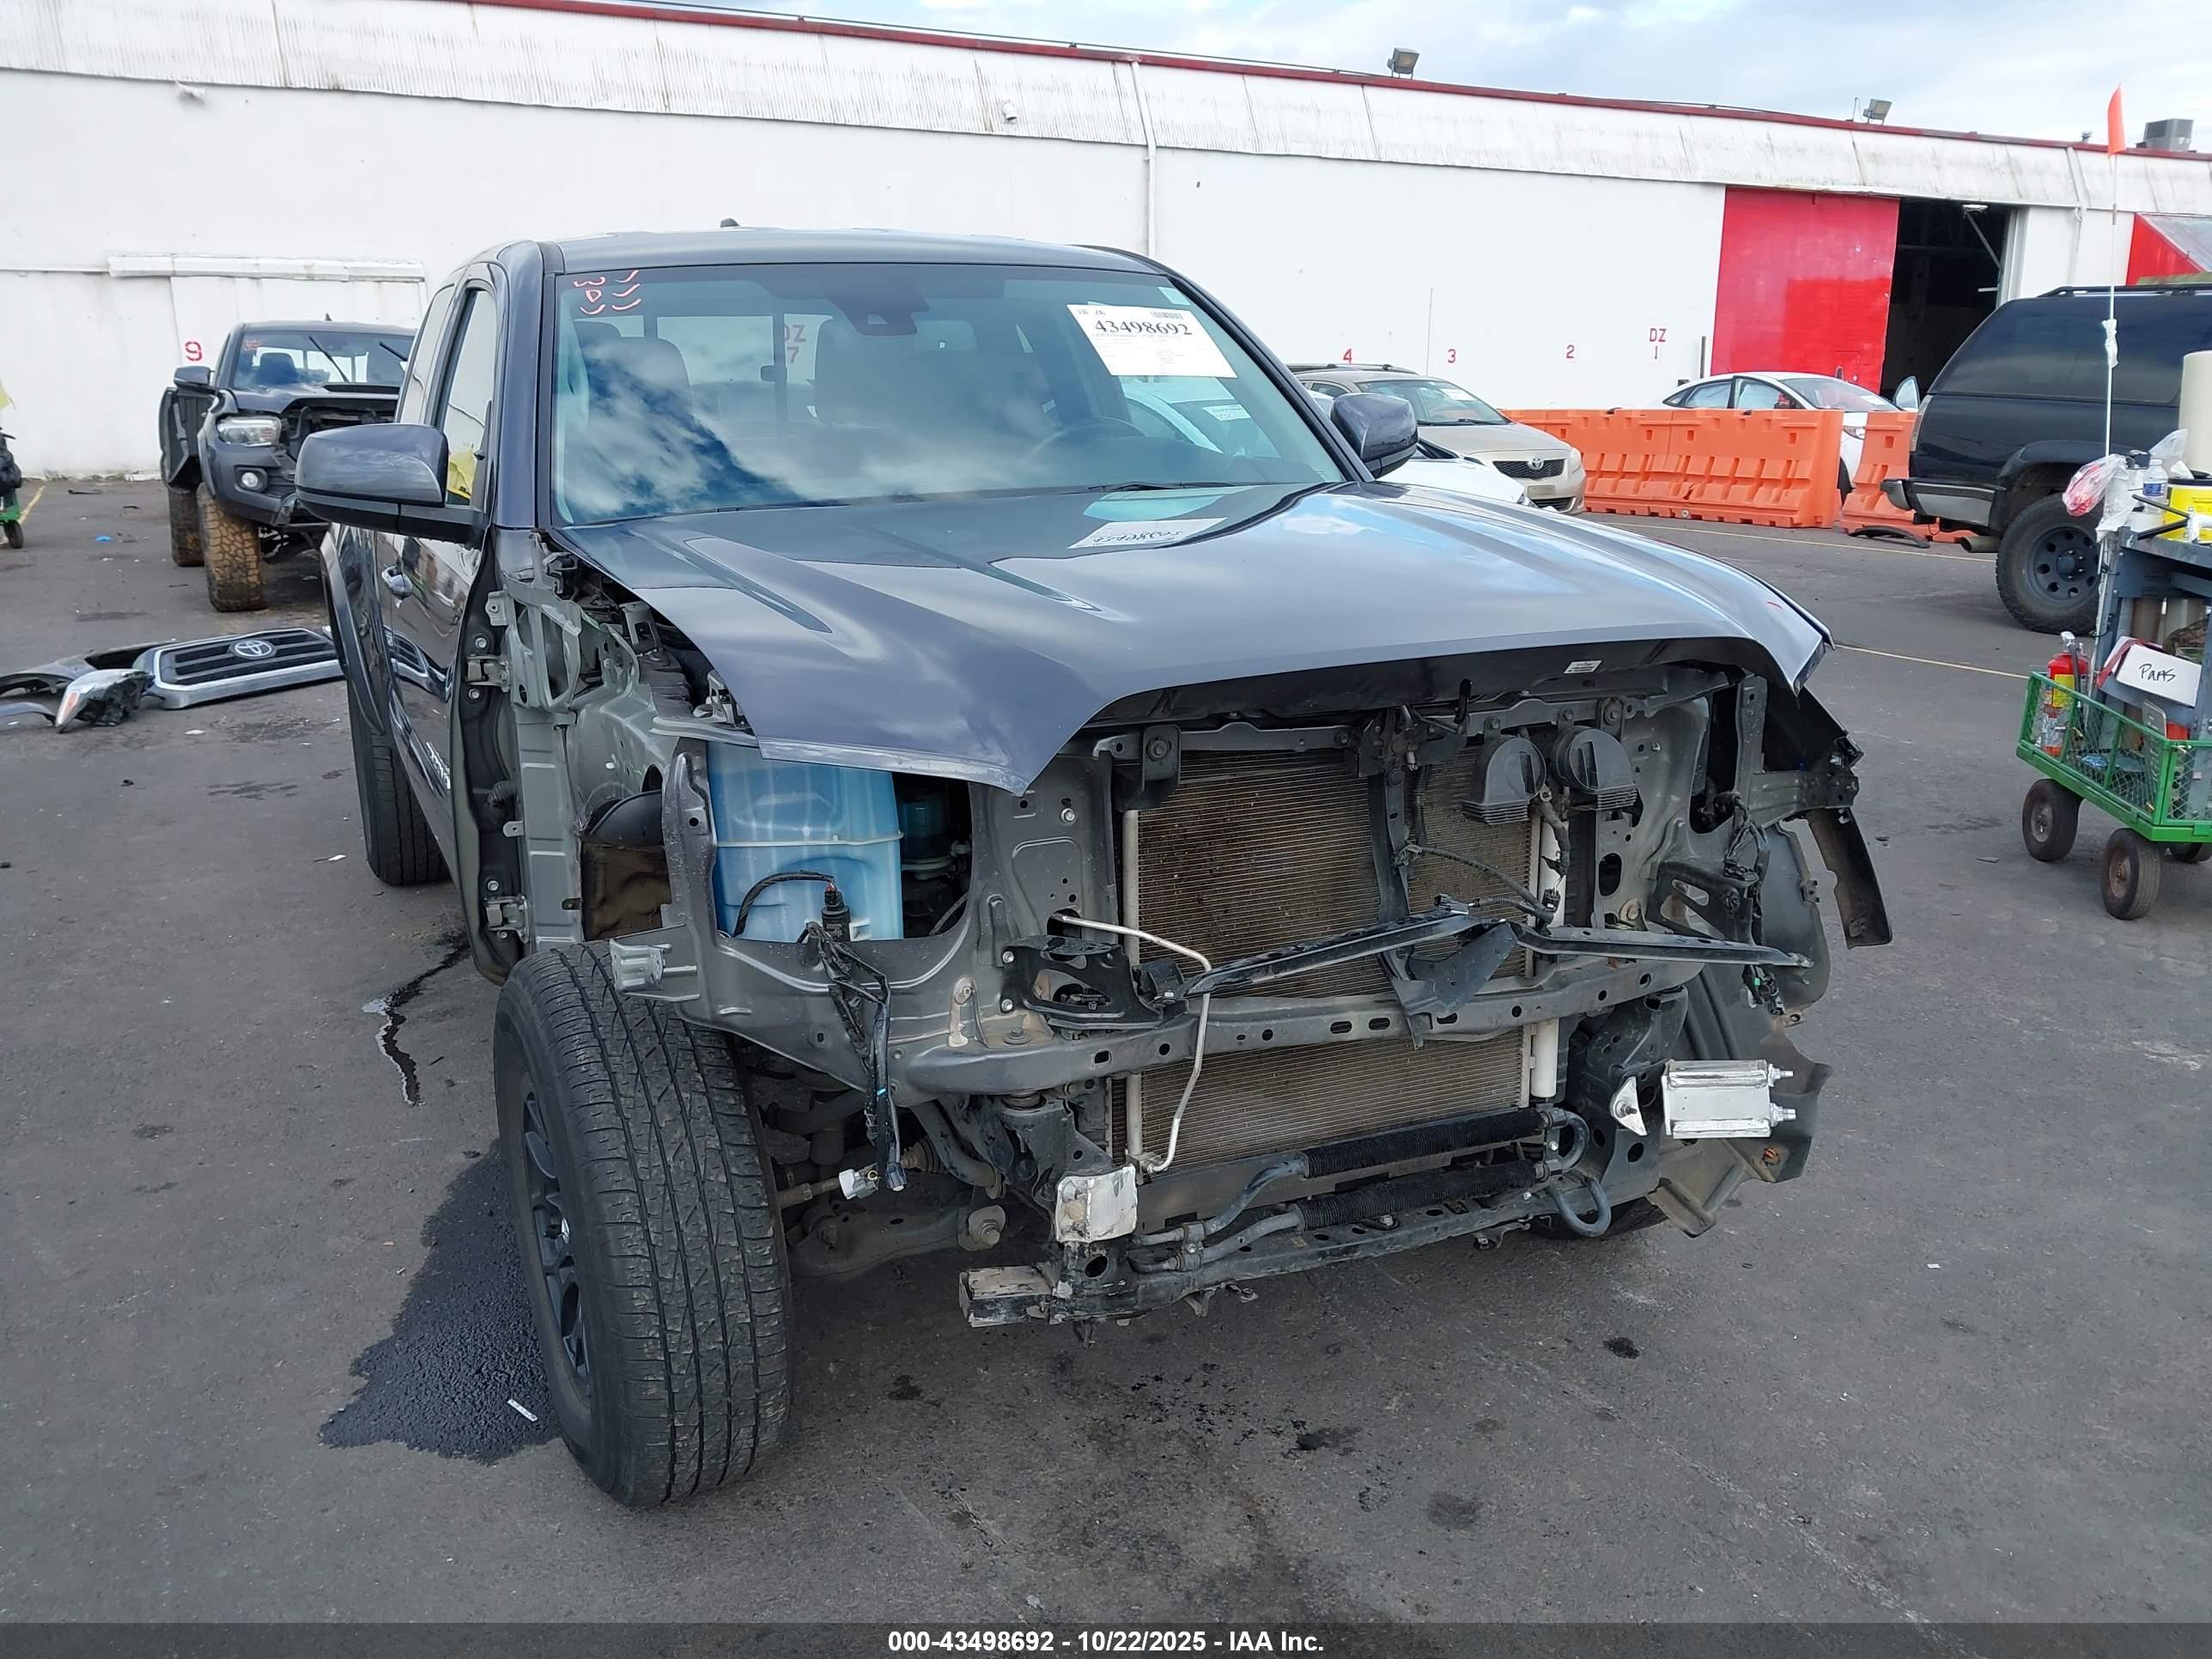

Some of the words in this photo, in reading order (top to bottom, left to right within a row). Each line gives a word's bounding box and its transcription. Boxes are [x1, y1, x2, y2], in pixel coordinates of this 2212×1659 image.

[1095, 319, 1194, 335] 43498692
[1650, 327, 1668, 343] DZ
[185, 340, 203, 362] 9
[787, 346, 799, 364] 7
[1343, 348, 1352, 364] 4
[1447, 348, 1456, 364] 3
[1565, 344, 1575, 359] 2
